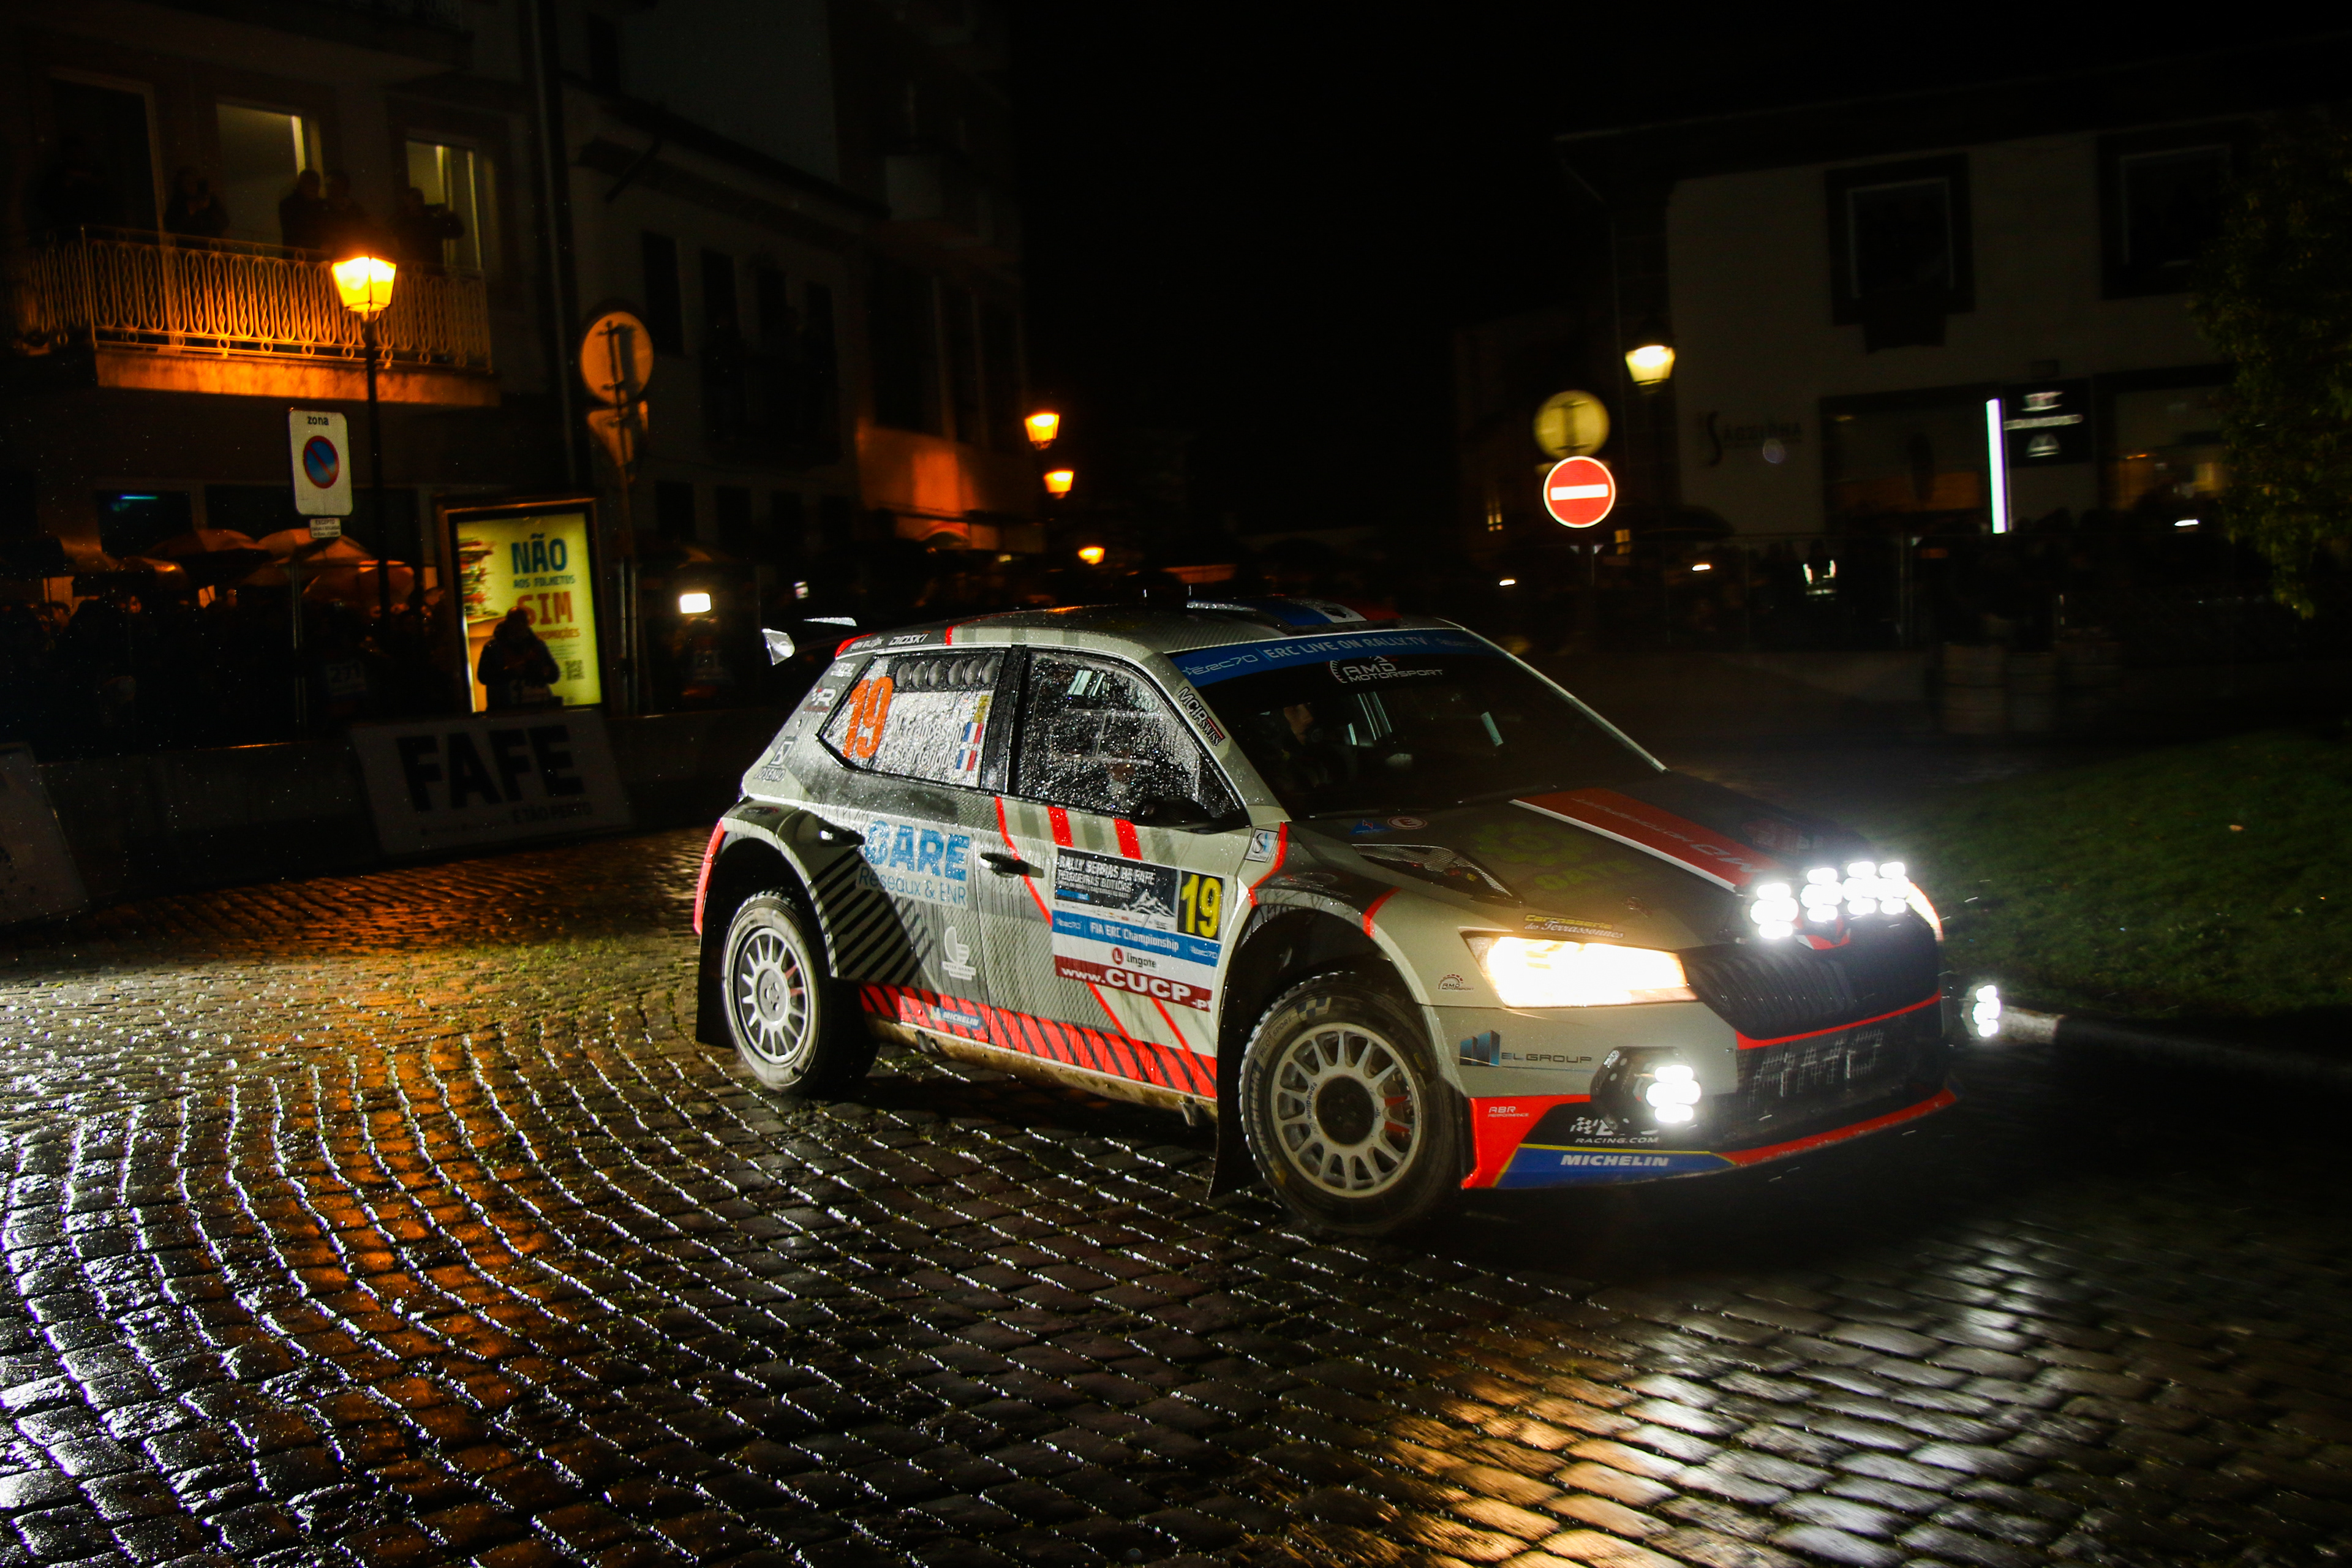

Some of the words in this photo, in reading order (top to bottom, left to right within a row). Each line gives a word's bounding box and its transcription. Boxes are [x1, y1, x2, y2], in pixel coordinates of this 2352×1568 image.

[307, 416, 330, 426] zona
[511, 533, 567, 574] NÃO
[518, 591, 573, 625] SIM
[1262, 646, 1301, 659] ERC
[1297, 641, 1339, 654] LIVE
[1336, 638, 1363, 649] ON
[1348, 669, 1444, 683] MOTORSPORT
[842, 676, 893, 759] 19
[396, 725, 586, 812] FAFE
[1058, 855, 1085, 872] RALLY
[859, 865, 921, 896] Réseaux
[925, 880, 936, 900] &
[940, 883, 967, 906] ENR
[1180, 874, 1222, 938] 19
[1089, 921, 1104, 936] FIA
[1106, 925, 1121, 939] ERC
[1123, 928, 1180, 952] Championship
[943, 1011, 979, 1027] MICHELIN
[1259, 1033, 1274, 1058] PILOT
[1272, 1016, 1292, 1037] SPORT
[1560, 1154, 1670, 1167] MICHELIN
